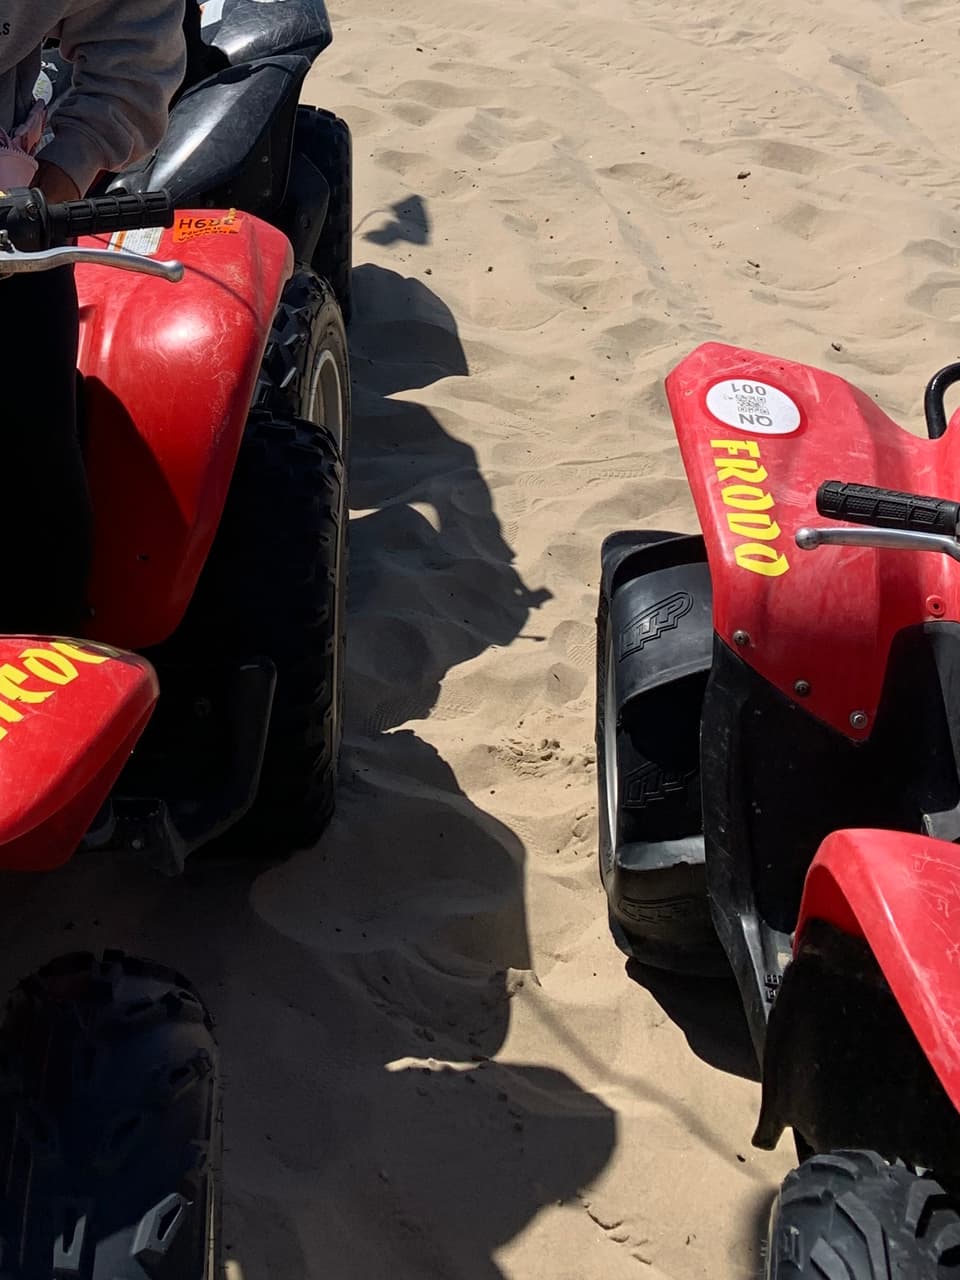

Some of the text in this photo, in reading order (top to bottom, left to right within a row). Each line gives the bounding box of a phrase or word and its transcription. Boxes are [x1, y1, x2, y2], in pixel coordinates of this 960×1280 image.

[731, 383, 767, 396] 001
[739, 413, 773, 427] QN
[710, 439, 790, 577] FRODO
